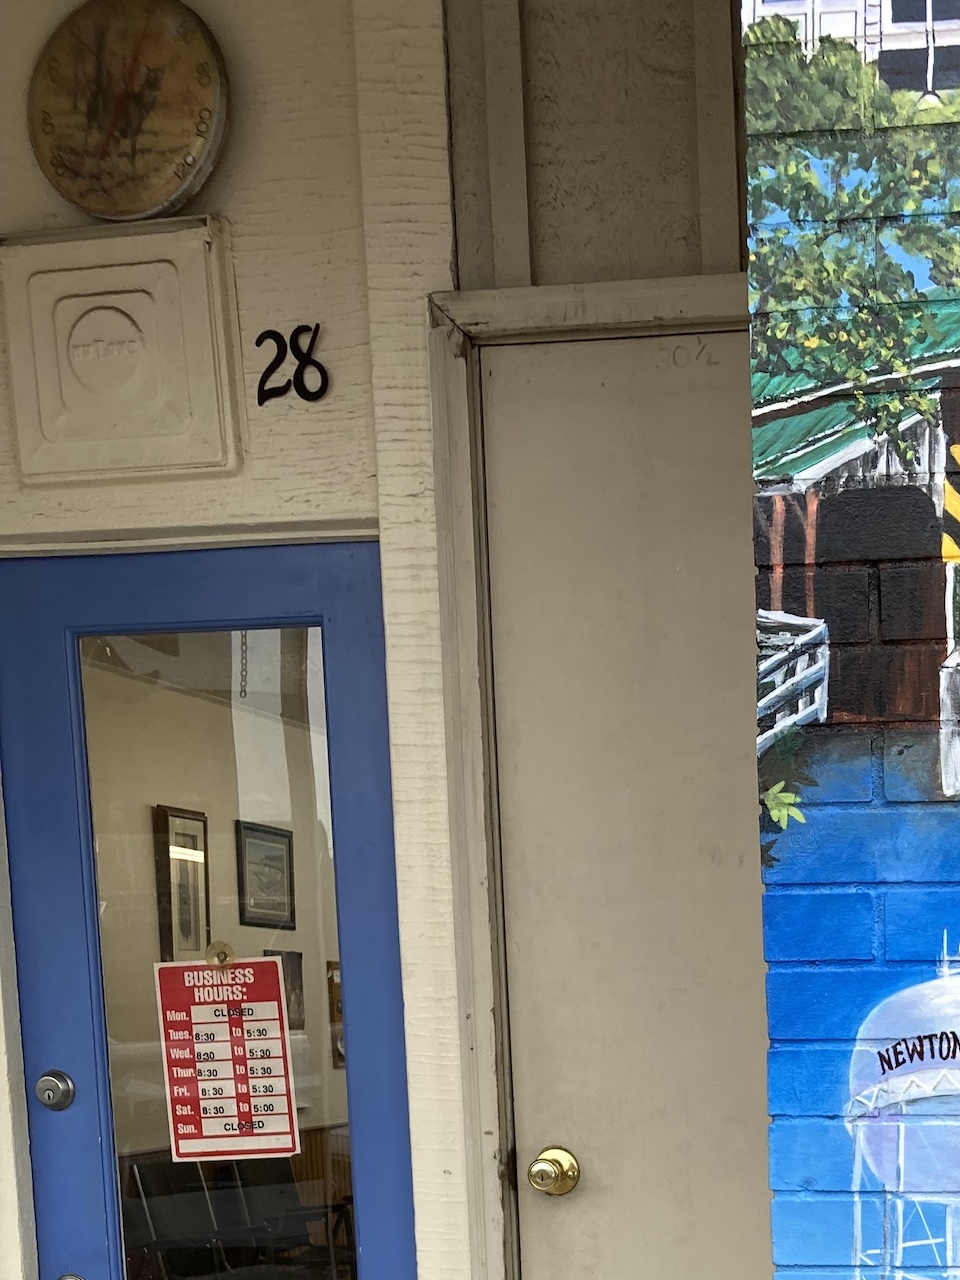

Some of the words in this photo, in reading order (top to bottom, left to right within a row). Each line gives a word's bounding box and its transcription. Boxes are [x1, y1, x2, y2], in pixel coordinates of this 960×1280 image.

[255, 323, 329, 407] 28
[184, 968, 255, 988] BUSINESS
[194, 986, 248, 1003] HOURS:
[166, 1010, 189, 1022] Mon.
[213, 1008, 254, 1018] CLOSED
[168, 1029, 193, 1040] Tues.
[194, 1032, 216, 1041] 8:30
[232, 1026, 242, 1037] to
[246, 1028, 268, 1038] 5:30
[170, 1048, 193, 1059] Wed.
[234, 1045, 244, 1056] to
[249, 1048, 271, 1058] 5:30
[172, 1066, 196, 1078] Thur.
[197, 1068, 218, 1077] 8:30
[236, 1064, 246, 1075] to
[249, 1066, 272, 1075] 5:30
[174, 1085, 190, 1097] Fri.
[201, 1087, 224, 1096] 8:30
[238, 1083, 248, 1094] to
[252, 1084, 274, 1093] 5:30
[175, 1104, 195, 1116] Sat.
[202, 1106, 225, 1115] 8:30
[239, 1101, 250, 1113] to
[253, 1103, 275, 1113] 5:00
[177, 1123, 198, 1135] Sun.
[224, 1120, 265, 1132] CLOSED
